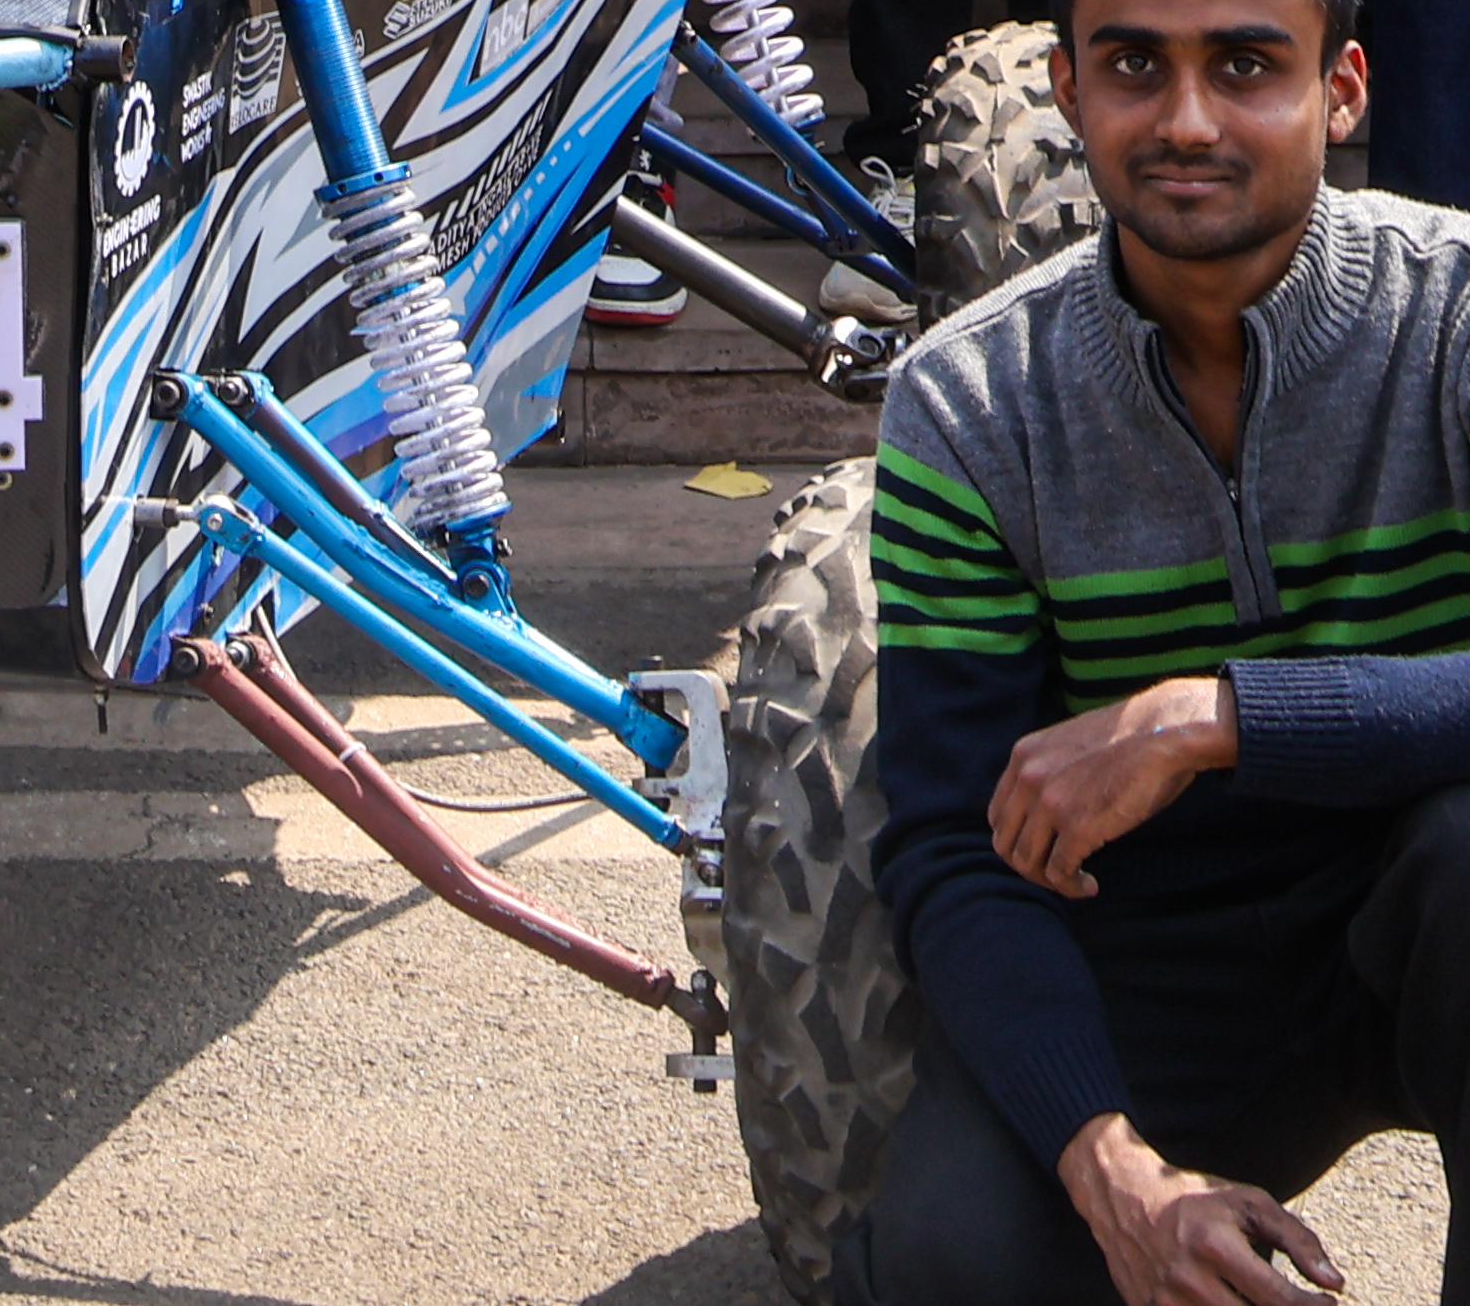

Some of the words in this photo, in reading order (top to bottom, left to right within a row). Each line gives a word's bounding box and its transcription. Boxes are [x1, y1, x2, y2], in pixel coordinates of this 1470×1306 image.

[181, 86, 225, 137] ENGINEERING
[182, 70, 213, 109] SWASTIK
[111, 232, 149, 279] BAZAR
